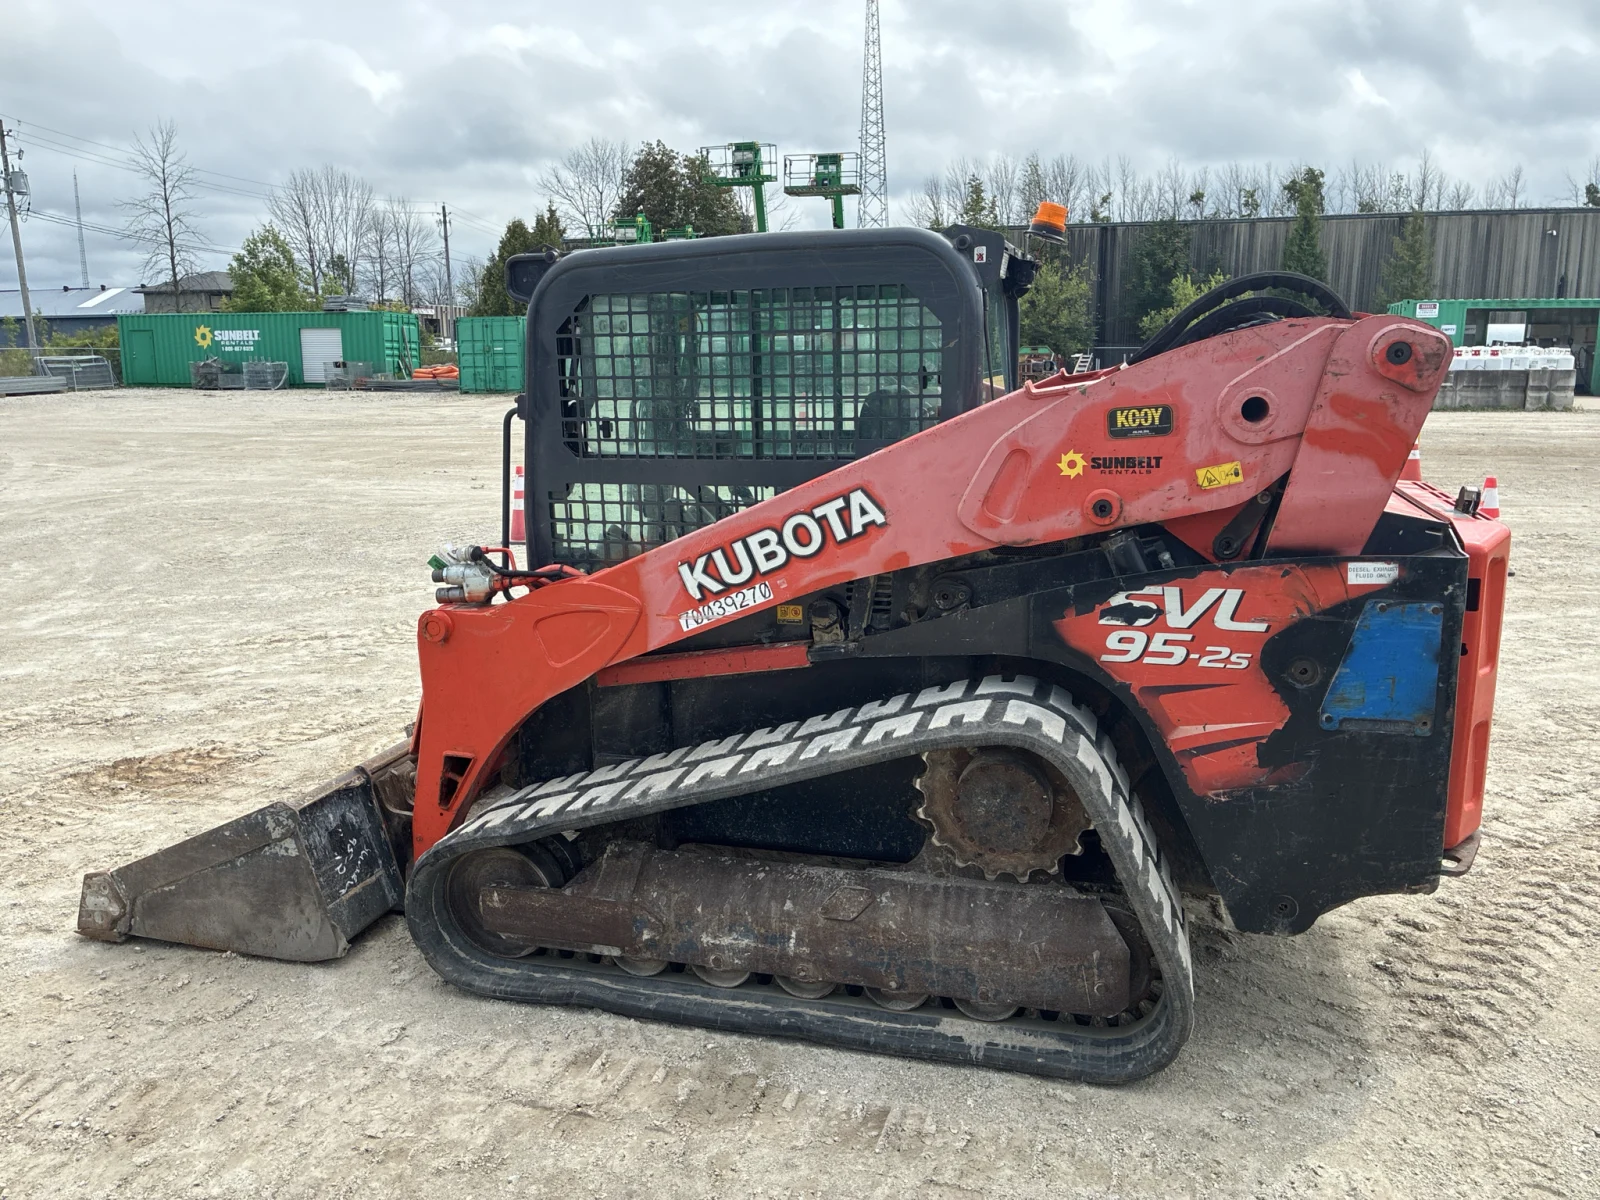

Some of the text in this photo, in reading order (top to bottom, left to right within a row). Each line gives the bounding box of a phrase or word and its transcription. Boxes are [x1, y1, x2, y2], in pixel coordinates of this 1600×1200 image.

[214, 330, 260, 341] SUNBELT
[1090, 456, 1163, 469] SUNBELT
[678, 488, 887, 600] KUBOTA
[679, 582, 772, 629] 70039270
[1098, 585, 1269, 633] SVL
